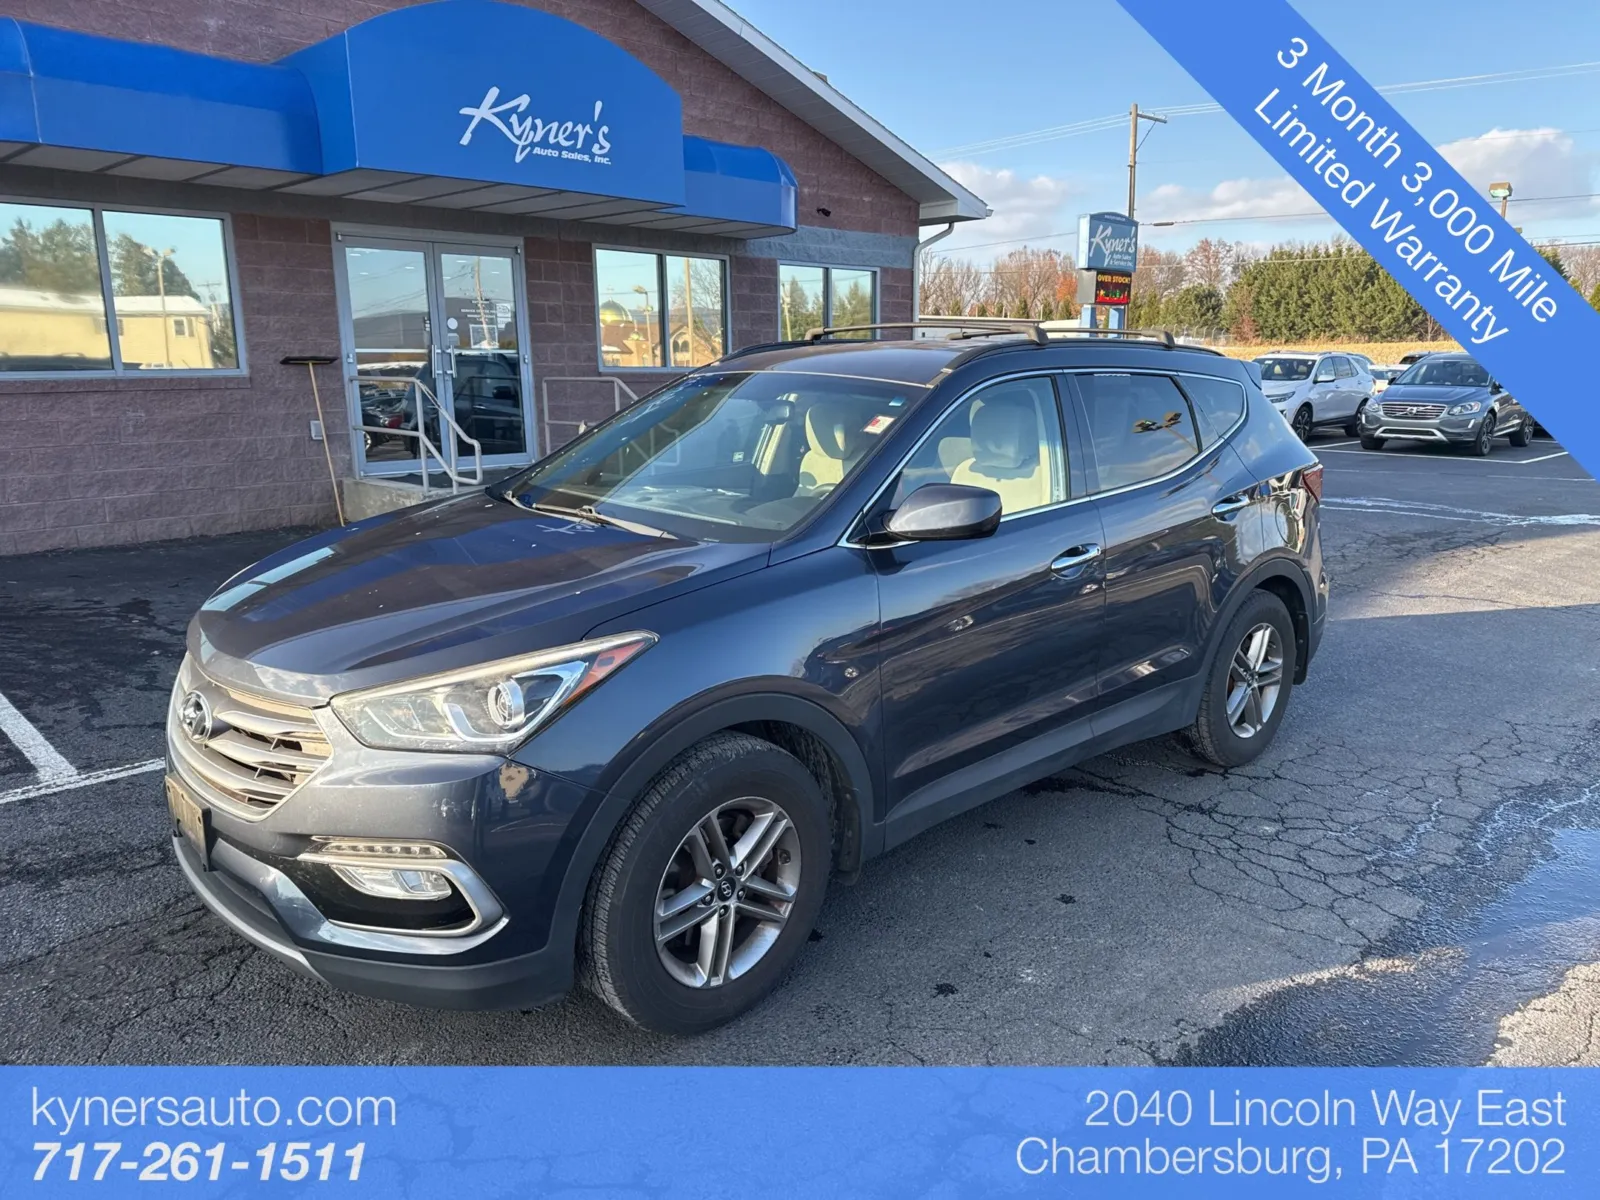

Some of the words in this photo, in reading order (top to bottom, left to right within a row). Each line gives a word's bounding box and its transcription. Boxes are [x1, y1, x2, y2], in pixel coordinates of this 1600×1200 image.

[459, 86, 611, 163] Kyner's
[532, 146, 559, 158] Auto
[561, 150, 592, 163] Sales,
[594, 154, 612, 165] Inc.
[1090, 224, 1136, 267] Kyner's
[1097, 274, 1112, 282] OVER
[1113, 275, 1131, 284] STOCK!
